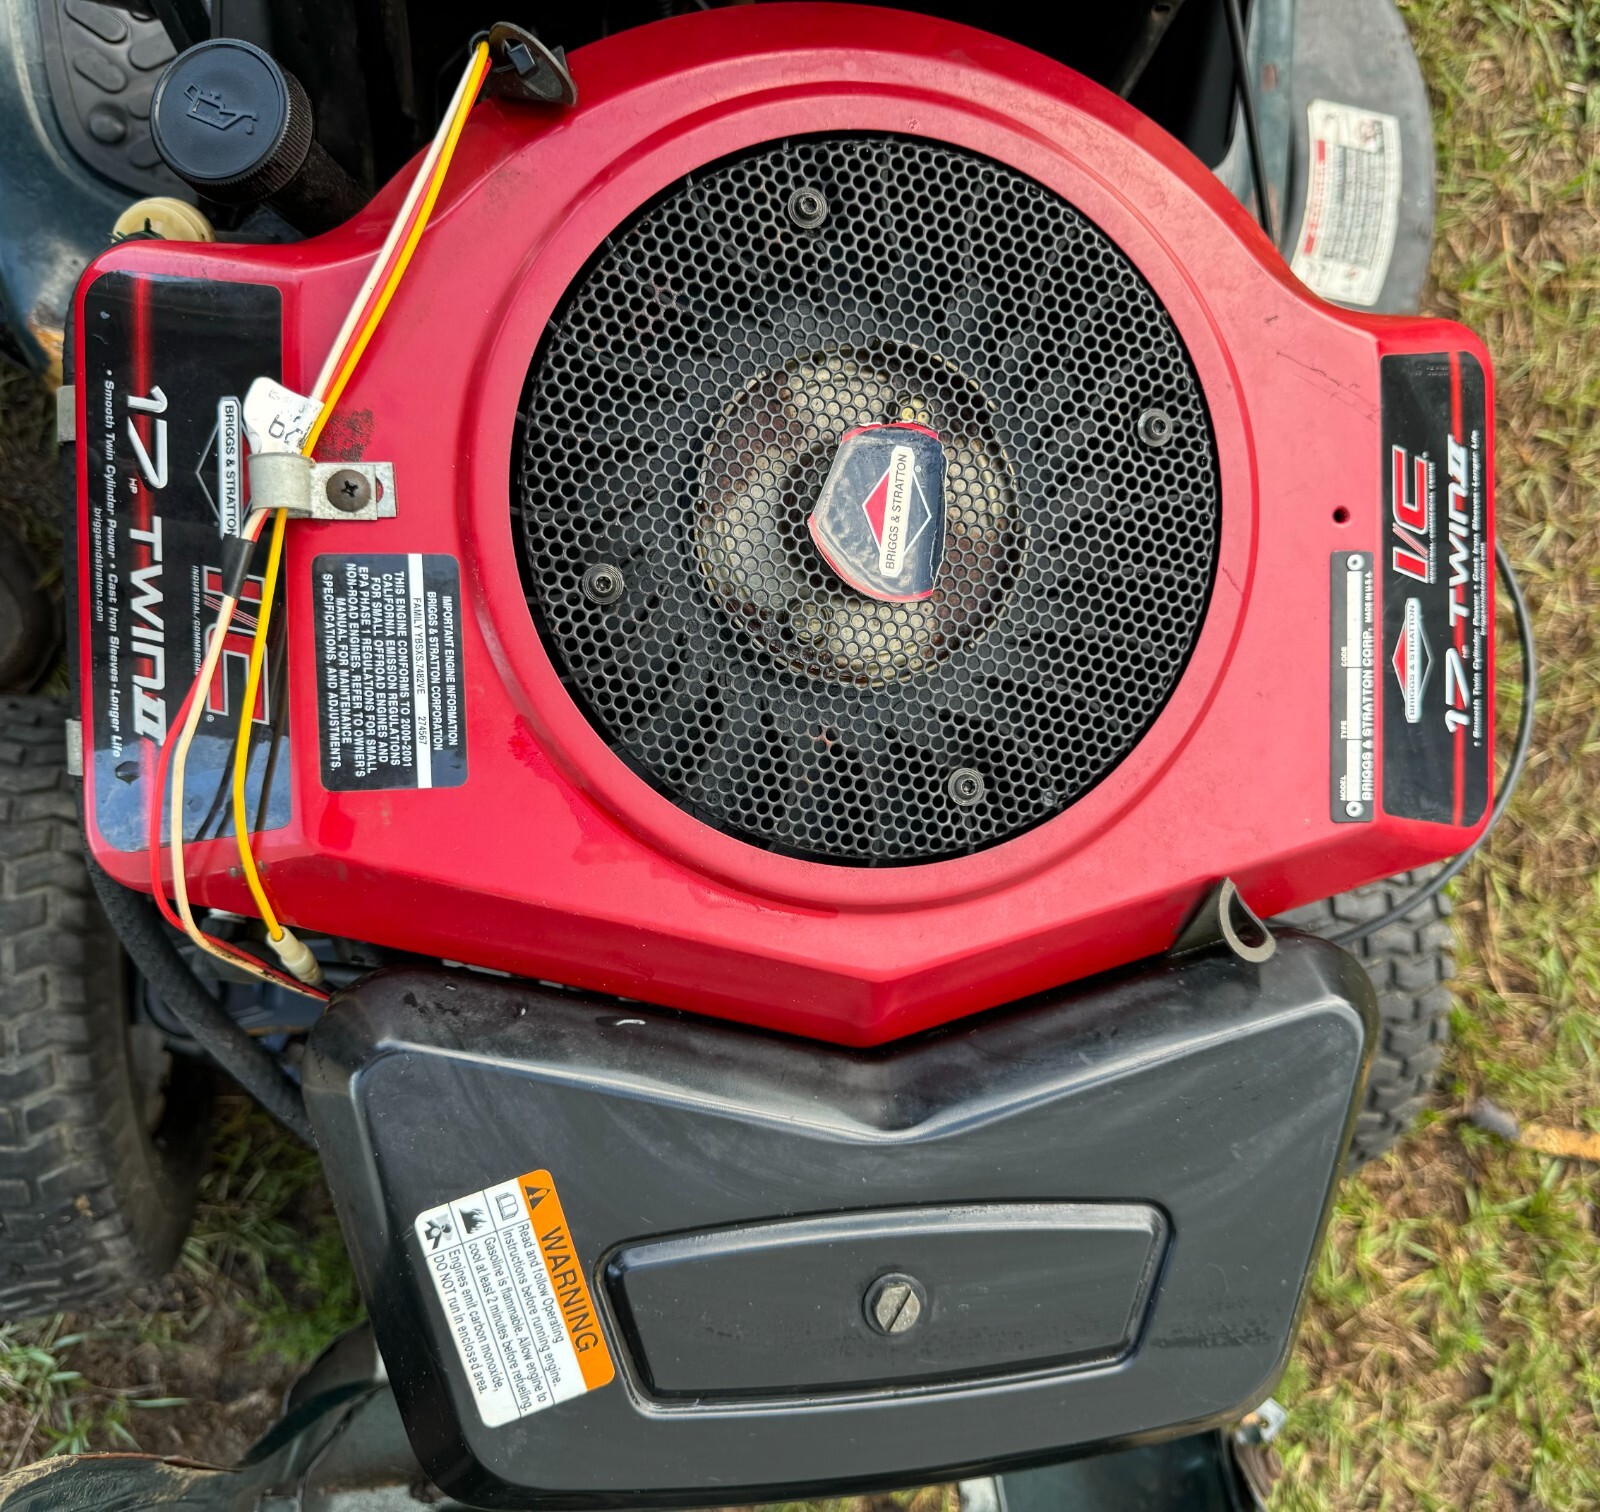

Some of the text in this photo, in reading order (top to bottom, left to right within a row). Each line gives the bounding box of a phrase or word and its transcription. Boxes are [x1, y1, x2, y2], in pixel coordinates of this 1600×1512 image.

[104, 380, 115, 428] Smooth
[105, 432, 115, 460] Twin
[126, 385, 169, 489] 17
[224, 405, 235, 455] BRIGGS
[1471, 429, 1479, 449] Life
[104, 465, 116, 515] Cylinder
[128, 478, 137, 494] HP
[225, 471, 237, 537] STRATTON
[885, 453, 907, 569] BRIGGS & STRATTON
[106, 519, 116, 558] Power
[1472, 533, 1480, 554] Iron
[93, 507, 106, 622] briggsandstratton.com
[358, 566, 369, 588] EPA
[1472, 557, 1480, 582] Cast
[107, 573, 119, 603] Cast
[359, 590, 370, 626] PHASE
[427, 591, 437, 626] BRIGGS
[1473, 593, 1481, 625] Power
[108, 607, 119, 632] Iron
[1364, 602, 1372, 623] MADE
[1408, 605, 1416, 660] STRATTON
[394, 571, 412, 767] THIS ENGINE CONFORMS TO 2000-2001
[428, 637, 440, 683] STRATTON
[1362, 627, 1373, 667] CORP.
[1473, 628, 1482, 670] Cylinder
[321, 573, 341, 771] SPECIFICATIONS, AND ADJUSTMENTS.
[335, 597, 351, 744] MANUAL FOR MAINTENANCE
[345, 563, 366, 777] NON-ROAD ENGINES. REFER TO OWNER'S
[361, 638, 374, 712] REGULATIONS
[370, 577, 388, 763] FOR SMALL OFFROAD ENGINES AND
[383, 573, 400, 766] CALIFORNIA EMISSION REGULATIONS
[412, 597, 422, 629] FAMILY
[417, 716, 427, 745] 274567
[442, 595, 457, 745] IMPORTANT ENGINE INFORMATION
[1444, 647, 1471, 733] 17
[1473, 672, 1481, 695] Twin
[1362, 669, 1374, 736] STRATTON
[1407, 674, 1415, 715] BRIGGS
[364, 715, 375, 736] FOR
[431, 686, 443, 750] CORPORATION
[1473, 699, 1481, 738] Smooth
[111, 735, 123, 757] Life
[365, 739, 377, 773] SMALL
[1362, 740, 1373, 749] &
[1362, 751, 1373, 801] BRIGGS
[468, 1242, 483, 1263] cool
[476, 1263, 487, 1273] at
[479, 1273, 495, 1296] least
[518, 1224, 566, 1343] Read and follow Operating
[539, 1225, 600, 1353] WARNING
[433, 1255, 489, 1395] DO NOT run in enclosed area.
[447, 1249, 506, 1392] Engines emit carbon monoxide,
[483, 1237, 548, 1402] Gasoline is flammable. Allow engine to
[490, 1304, 510, 1340] minutes
[502, 1229, 563, 1387] Instructions before running engine.
[502, 1340, 520, 1368] before
[509, 1369, 535, 1412] refueling.
